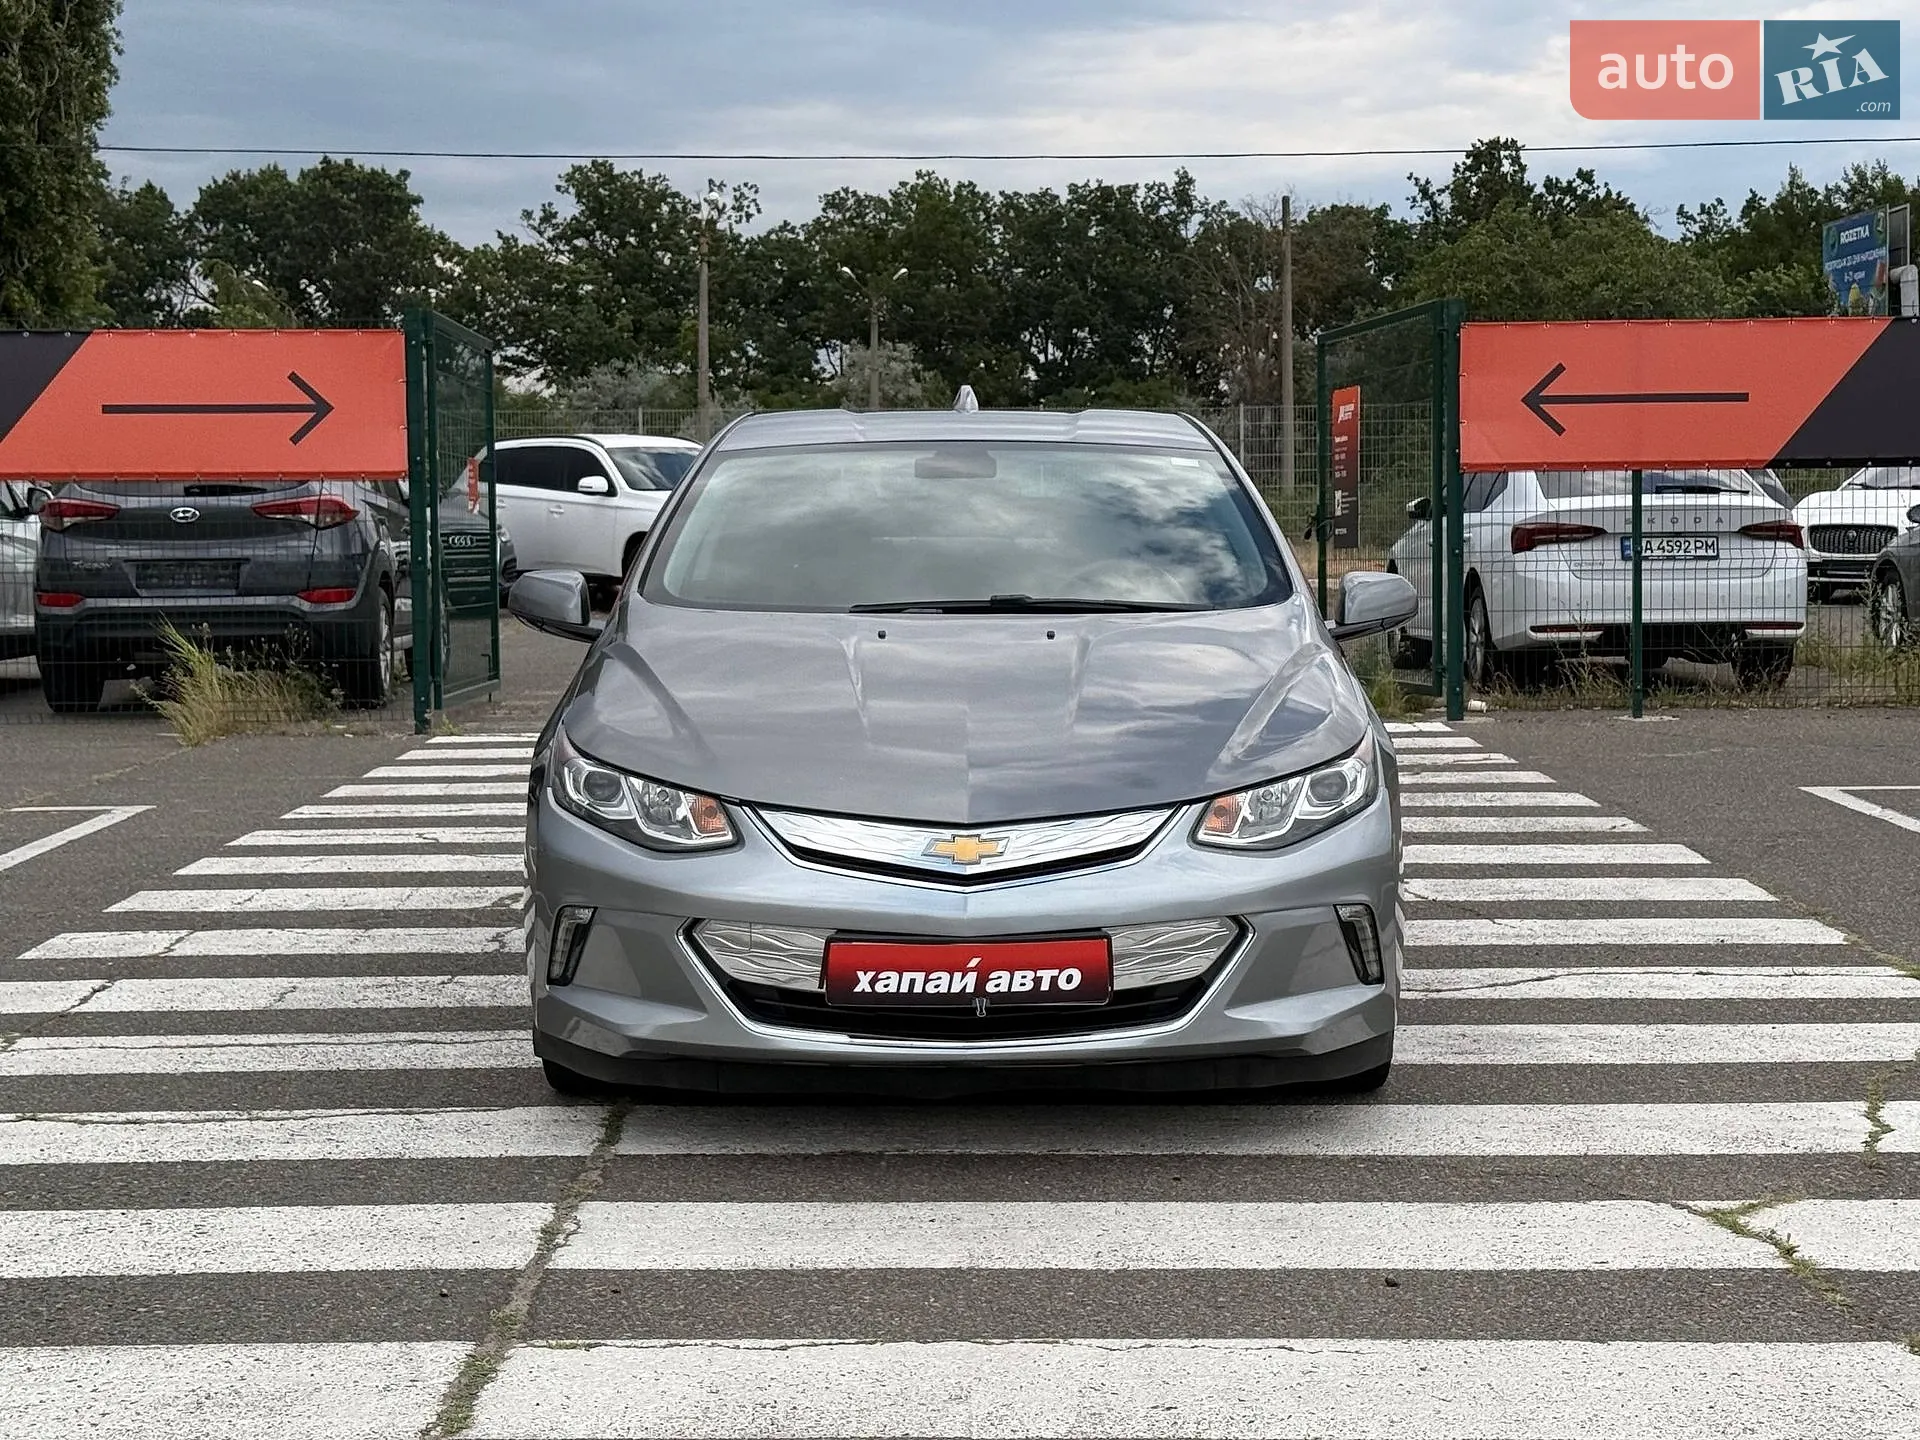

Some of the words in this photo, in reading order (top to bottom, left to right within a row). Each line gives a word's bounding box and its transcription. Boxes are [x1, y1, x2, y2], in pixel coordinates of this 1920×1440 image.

[1656, 539, 1692, 554] 4592
[1694, 539, 1715, 554] PM
[985, 967, 1082, 993] авто
